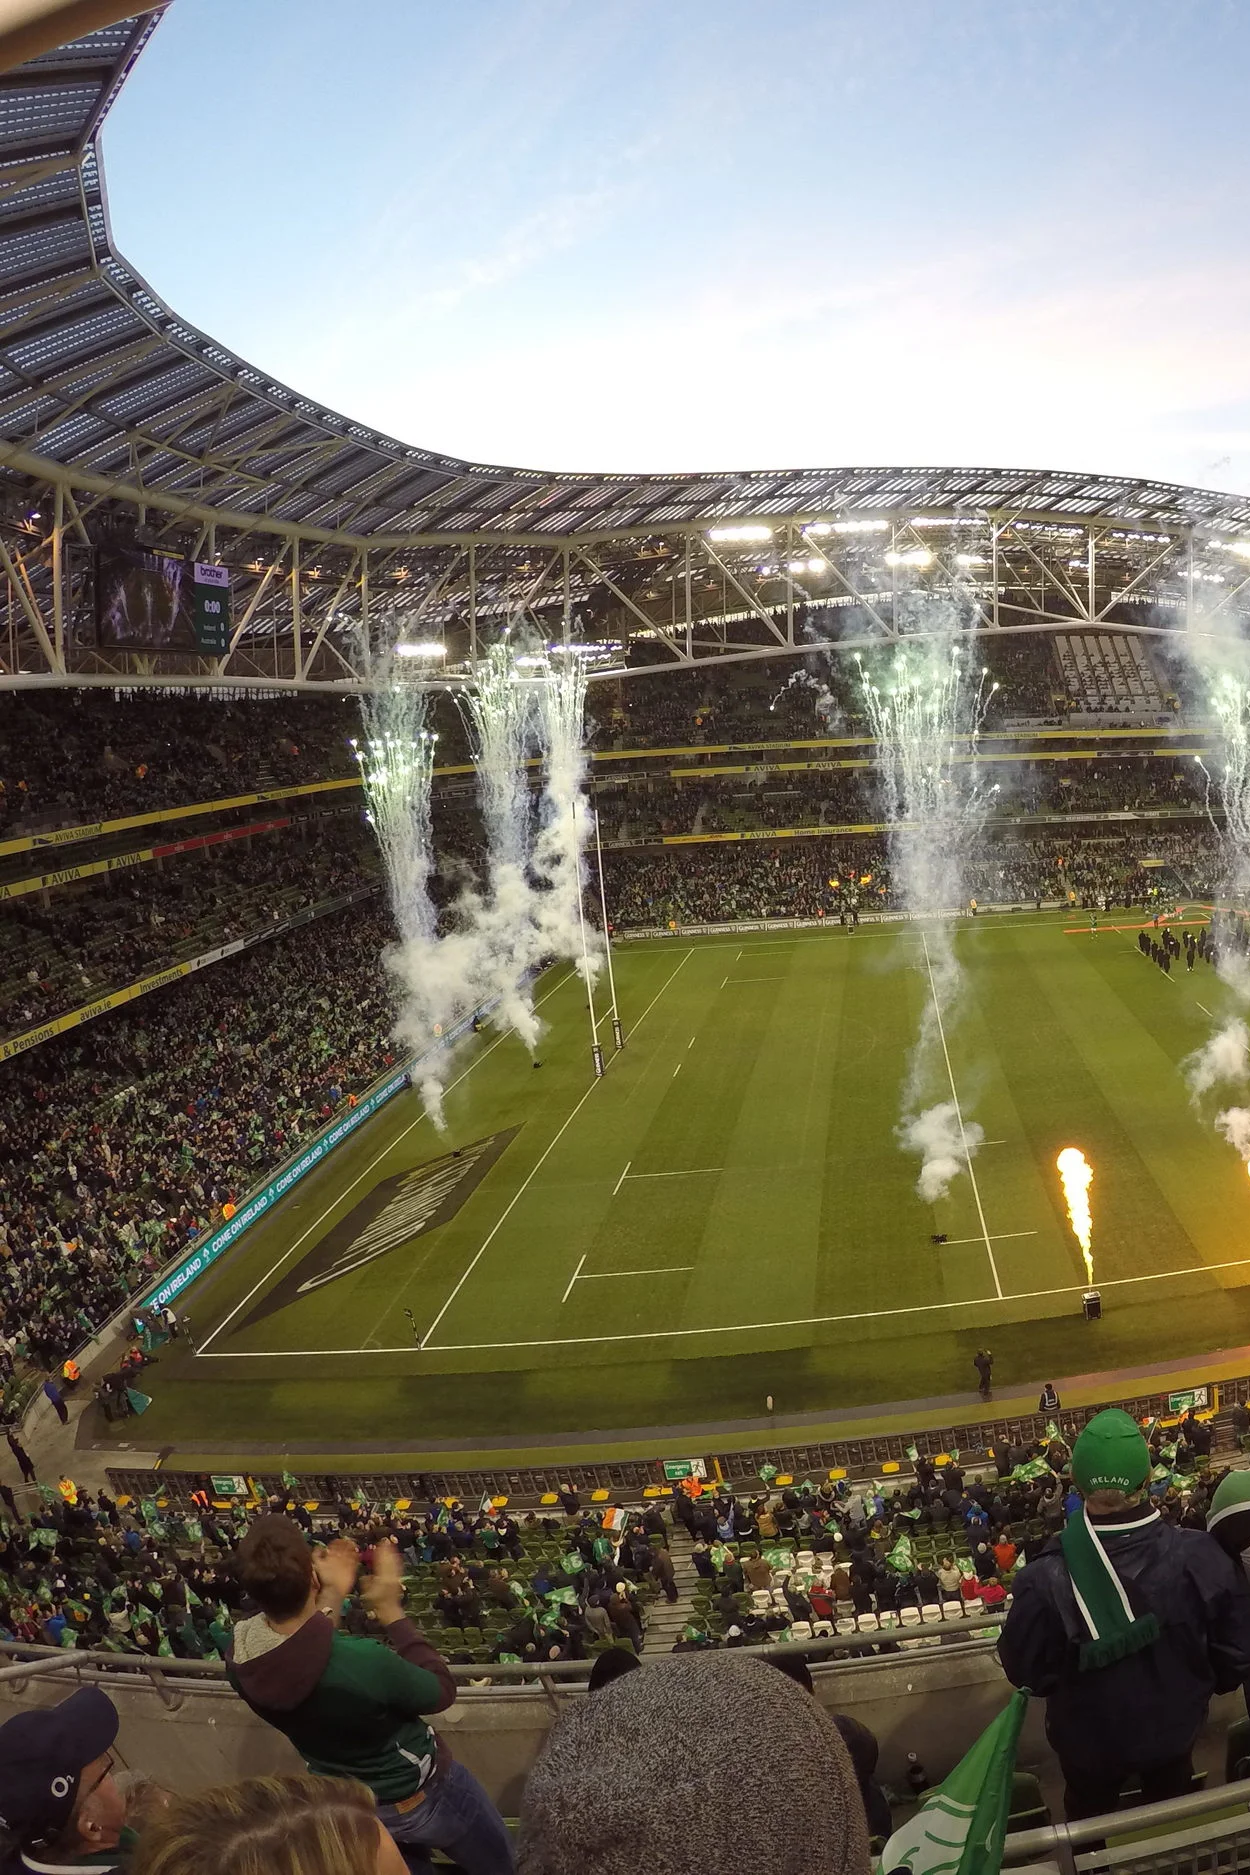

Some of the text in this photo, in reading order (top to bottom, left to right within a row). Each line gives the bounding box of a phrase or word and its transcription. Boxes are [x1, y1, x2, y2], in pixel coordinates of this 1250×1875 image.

[200, 565, 223, 579] brother
[204, 600, 220, 614] 0:00
[54, 830, 74, 842] AVIVA
[750, 831, 777, 839] AVIVA
[116, 853, 142, 868] AVIVA
[52, 869, 81, 885] AVIVA
[138, 967, 183, 994] Investments
[80, 1000, 112, 1022] aviva.ie
[3, 1025, 54, 1058] & Pensions
[328, 1128, 344, 1144] COME
[349, 1104, 370, 1126] IRELAND
[276, 1145, 323, 1193] COME ON IRELAND
[211, 1196, 268, 1252] COME ON IRELAND
[158, 1257, 202, 1304] ON IRELAND
[1089, 1476, 1130, 1486] IRELAND
[51, 1774, 75, 1798] O2
